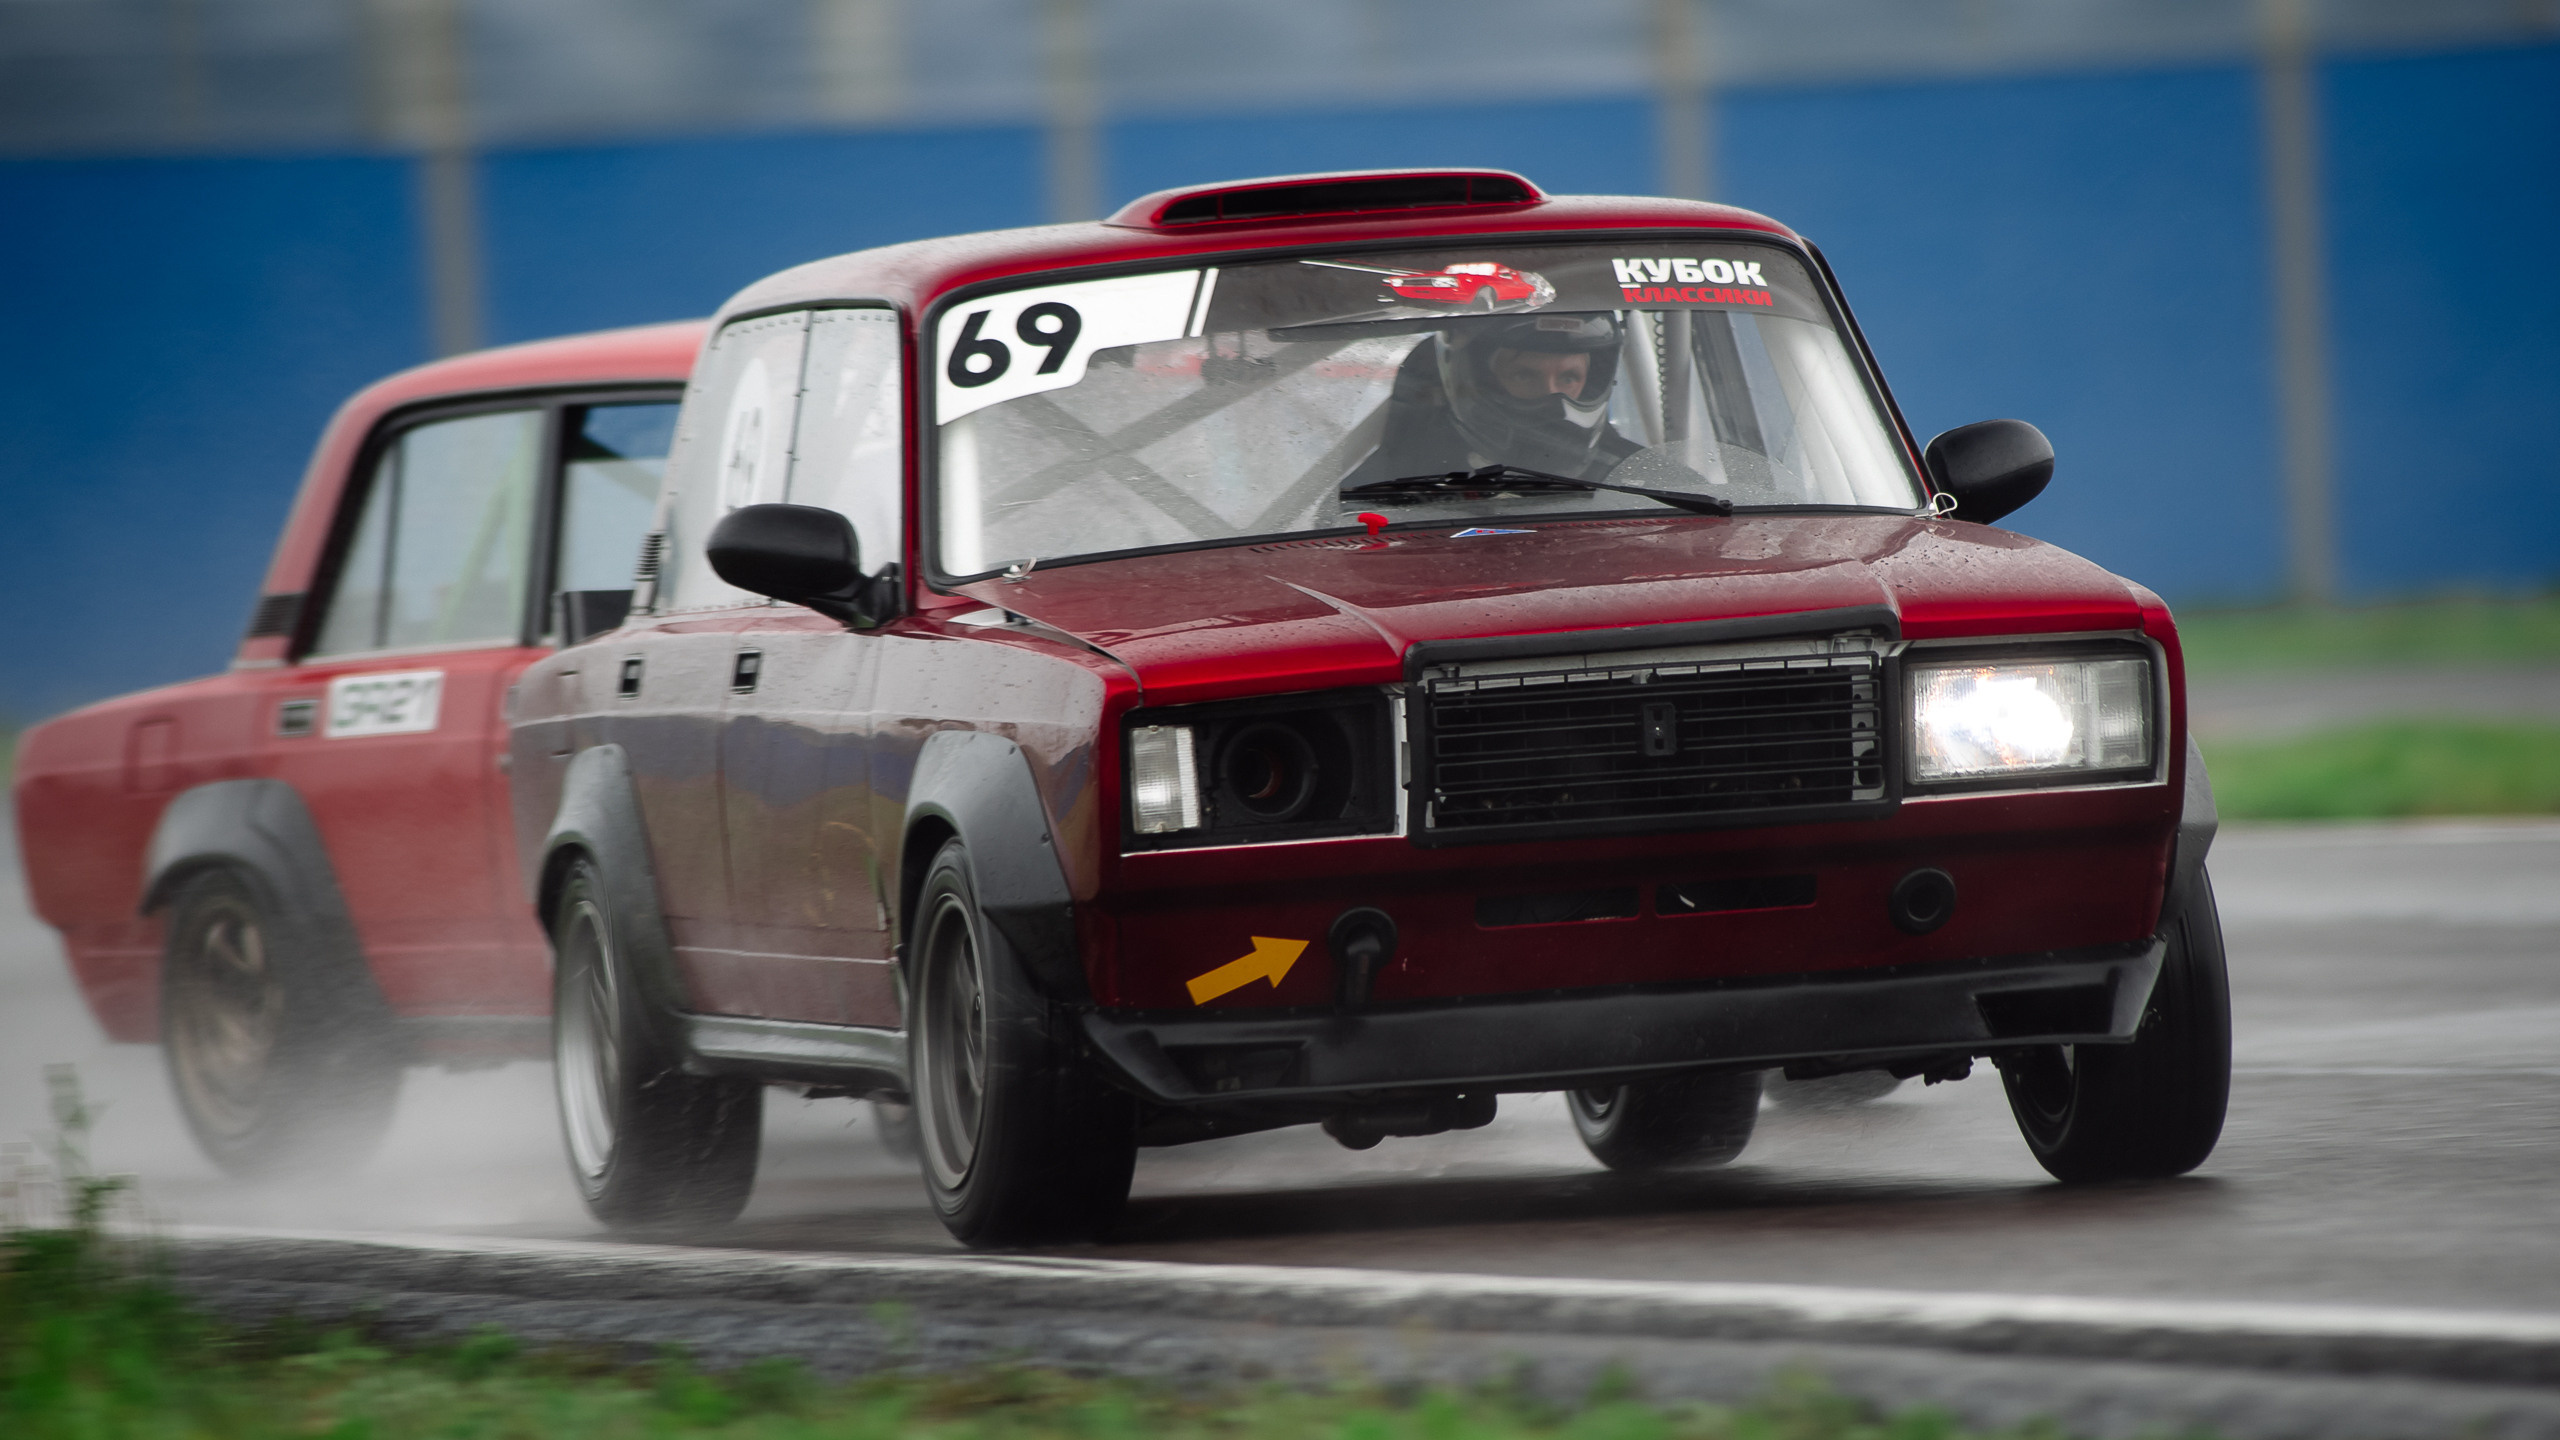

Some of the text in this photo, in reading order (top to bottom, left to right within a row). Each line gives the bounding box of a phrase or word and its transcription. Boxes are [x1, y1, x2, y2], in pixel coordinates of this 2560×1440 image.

[1611, 258, 1768, 287] КУБОК
[1622, 286, 1773, 306] КЛАССИКИ
[948, 302, 1081, 388] 69
